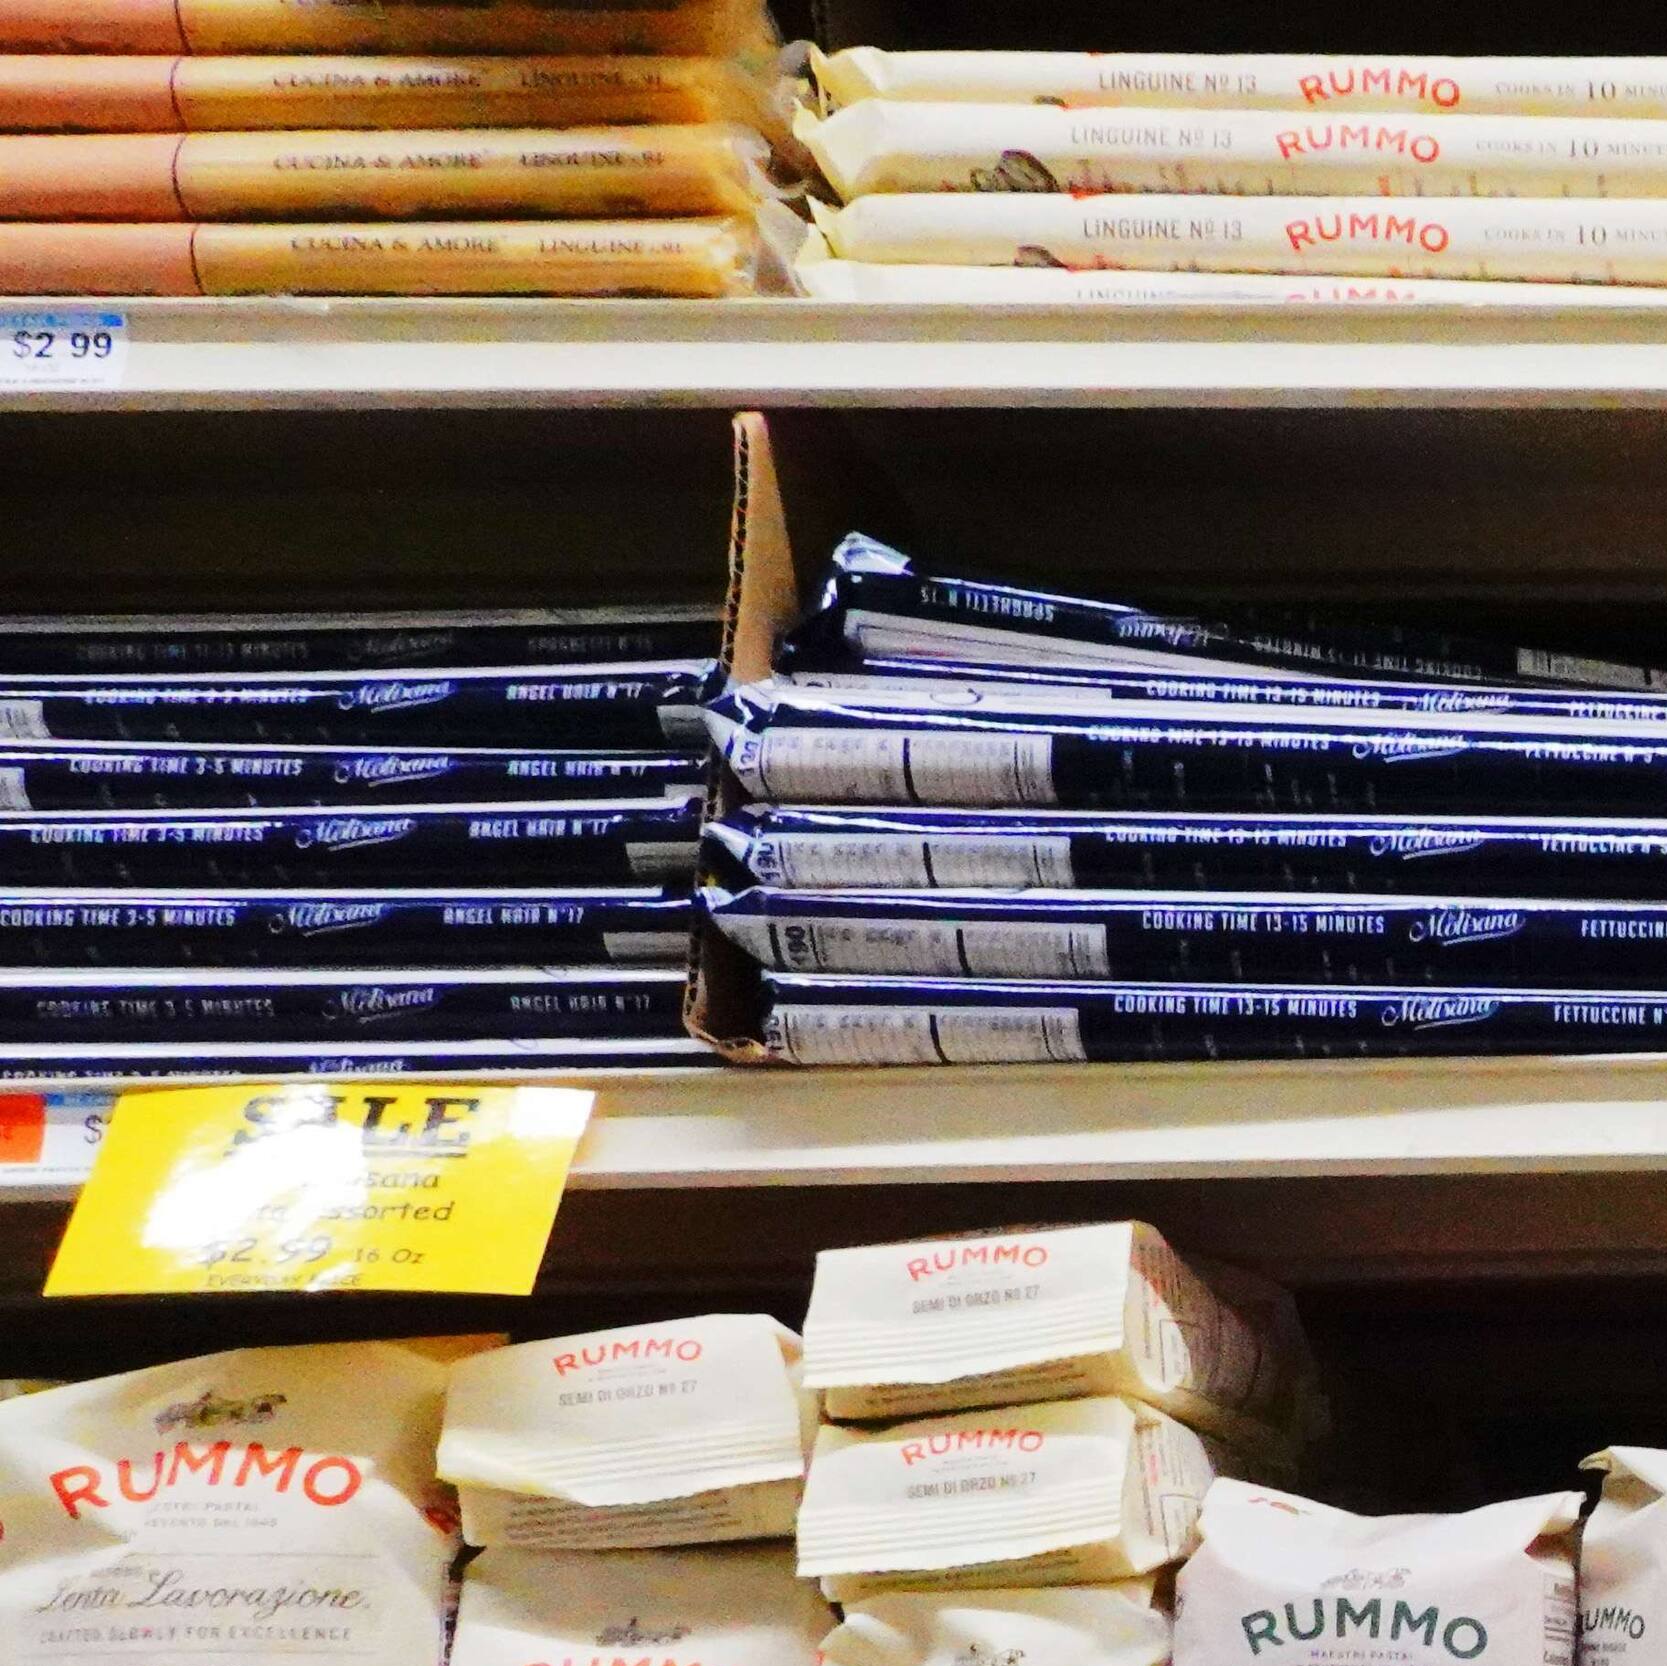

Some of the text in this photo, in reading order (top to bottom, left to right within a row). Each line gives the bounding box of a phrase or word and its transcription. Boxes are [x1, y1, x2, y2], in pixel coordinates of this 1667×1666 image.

[1099, 72, 1196, 92] LINGUINE
[1298, 67, 1461, 107] RUMMO
[1586, 80, 1618, 101] 10
[1142, 911, 1214, 931] COOKING
[1220, 912, 1257, 931] TIME
[1266, 912, 1309, 932] 13-15
[1316, 913, 1385, 934] MINUTES
[905, 1244, 1049, 1284] RUMMO
[49, 1440, 364, 1519] RUMMO
[1241, 1596, 1488, 1660] RUMMO
